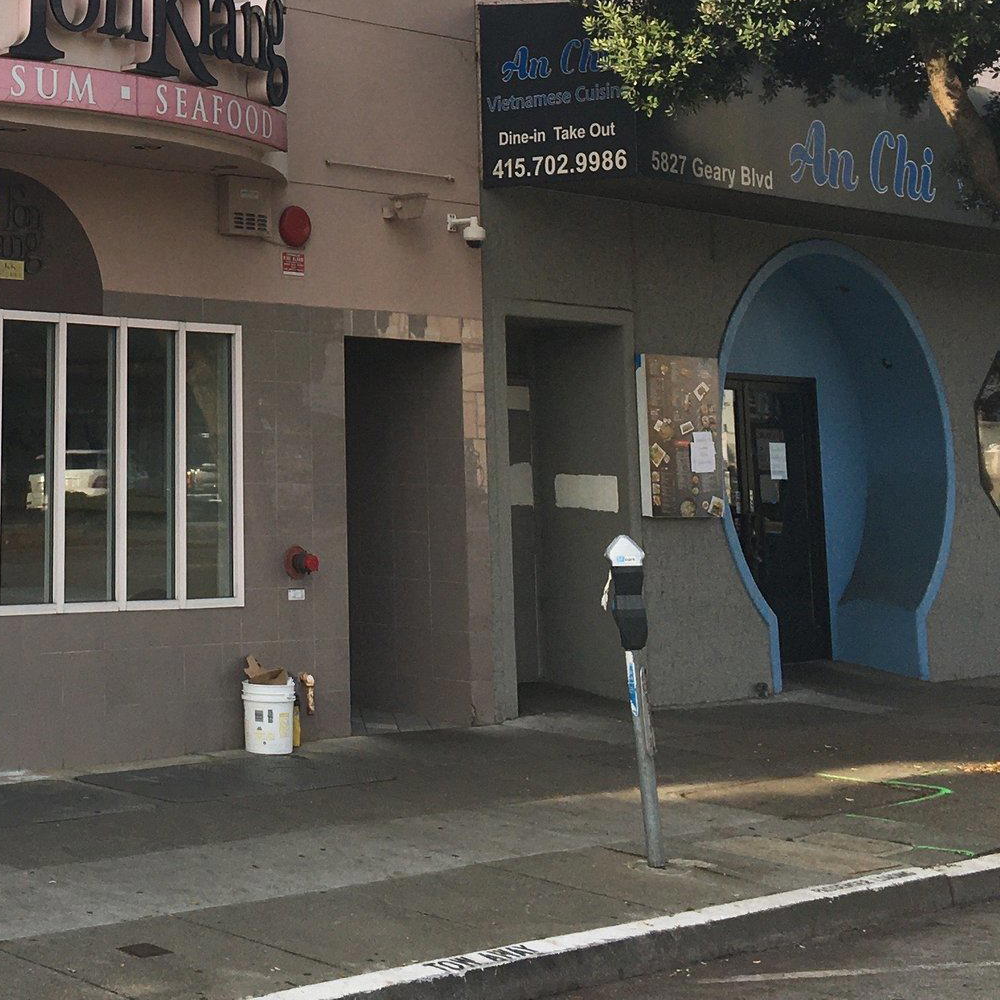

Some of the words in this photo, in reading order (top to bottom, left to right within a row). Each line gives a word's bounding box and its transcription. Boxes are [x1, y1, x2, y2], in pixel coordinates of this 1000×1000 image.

[501, 45, 552, 82] An
[560, 38, 608, 75] Ch
[10, 64, 96, 104] SUM
[155, 84, 274, 140] SEAFOOD
[486, 90, 572, 113] Vietnamese
[574, 82, 621, 103] Cuisin
[499, 129, 546, 146] Dine-in
[553, 125, 586, 141] Take
[589, 121, 616, 138] Out
[492, 148, 628, 179] 415.702.9986
[651, 150, 687, 175] 5827
[692, 157, 737, 189] Geary
[741, 165, 773, 190] Blvd
[789, 119, 859, 192] An
[869, 130, 937, 203] Chi
